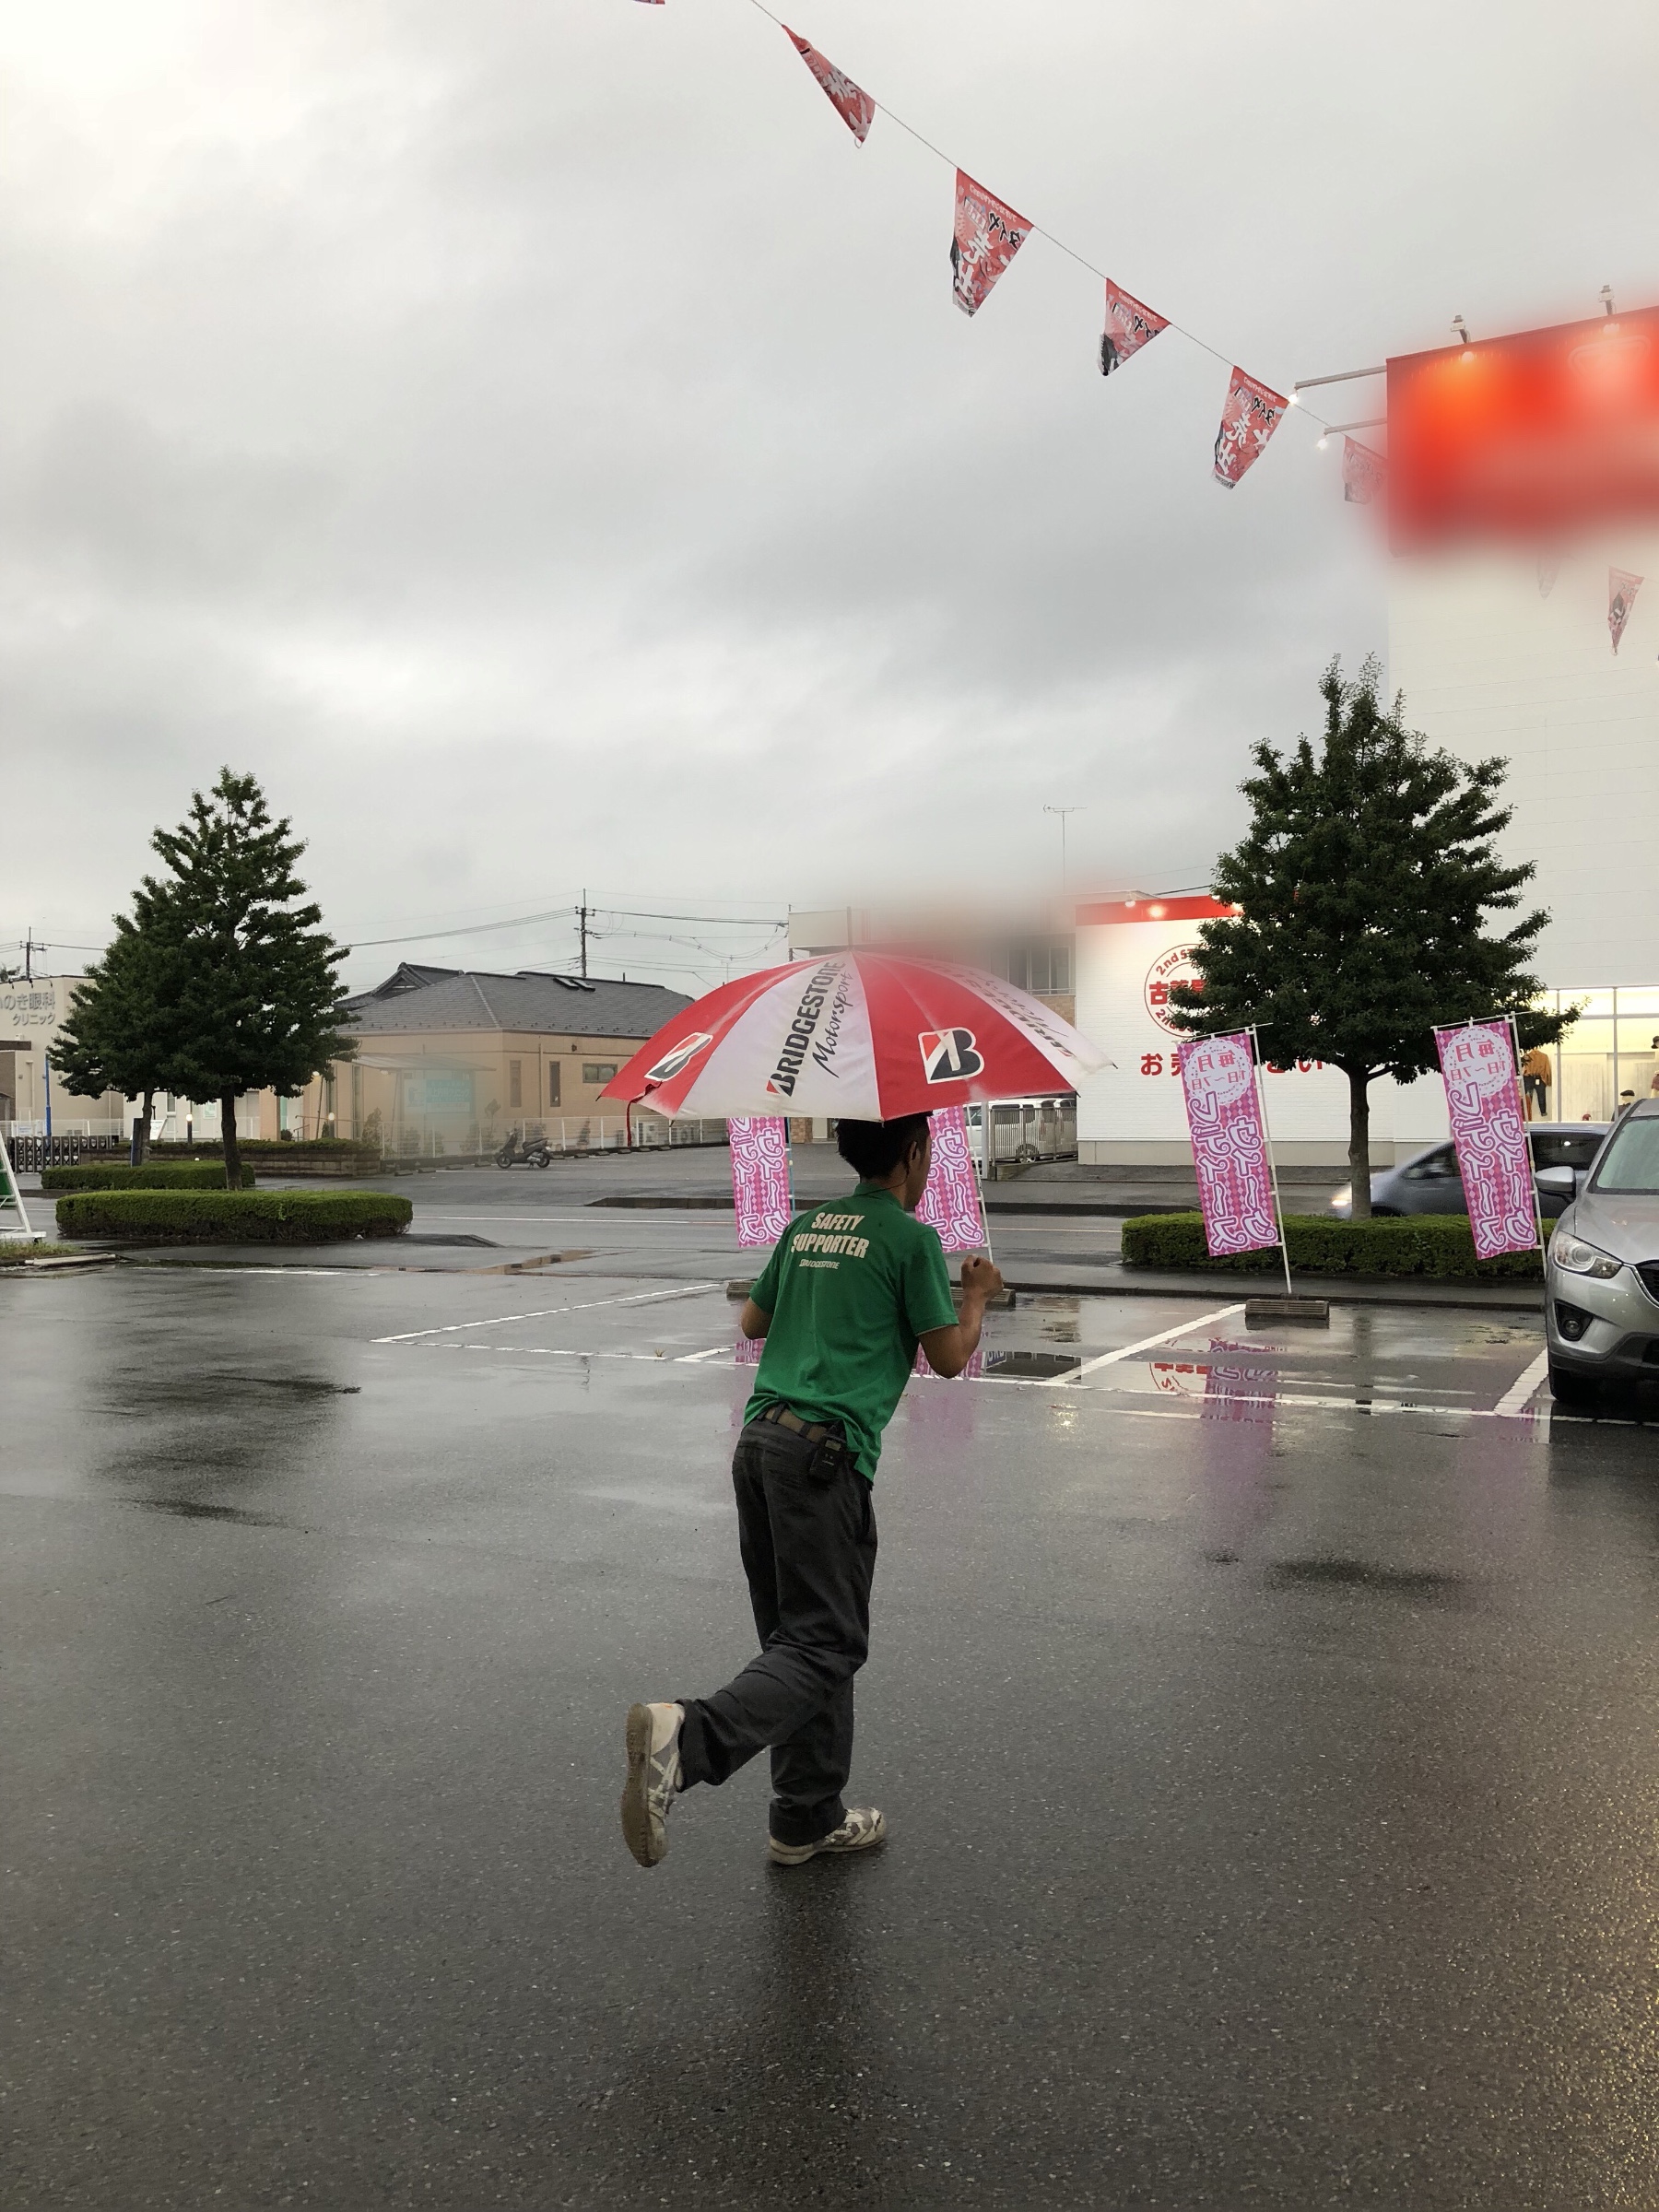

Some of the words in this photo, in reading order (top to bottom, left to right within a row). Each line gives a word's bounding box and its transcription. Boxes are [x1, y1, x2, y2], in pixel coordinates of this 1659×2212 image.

[12, 1012, 56, 1026] クリニック
[766, 961, 847, 1097] BRIDGESTONE
[812, 971, 853, 1079] Motorsport
[811, 1212, 866, 1231] SAFETY
[791, 1233, 870, 1259] SUPPORTER
